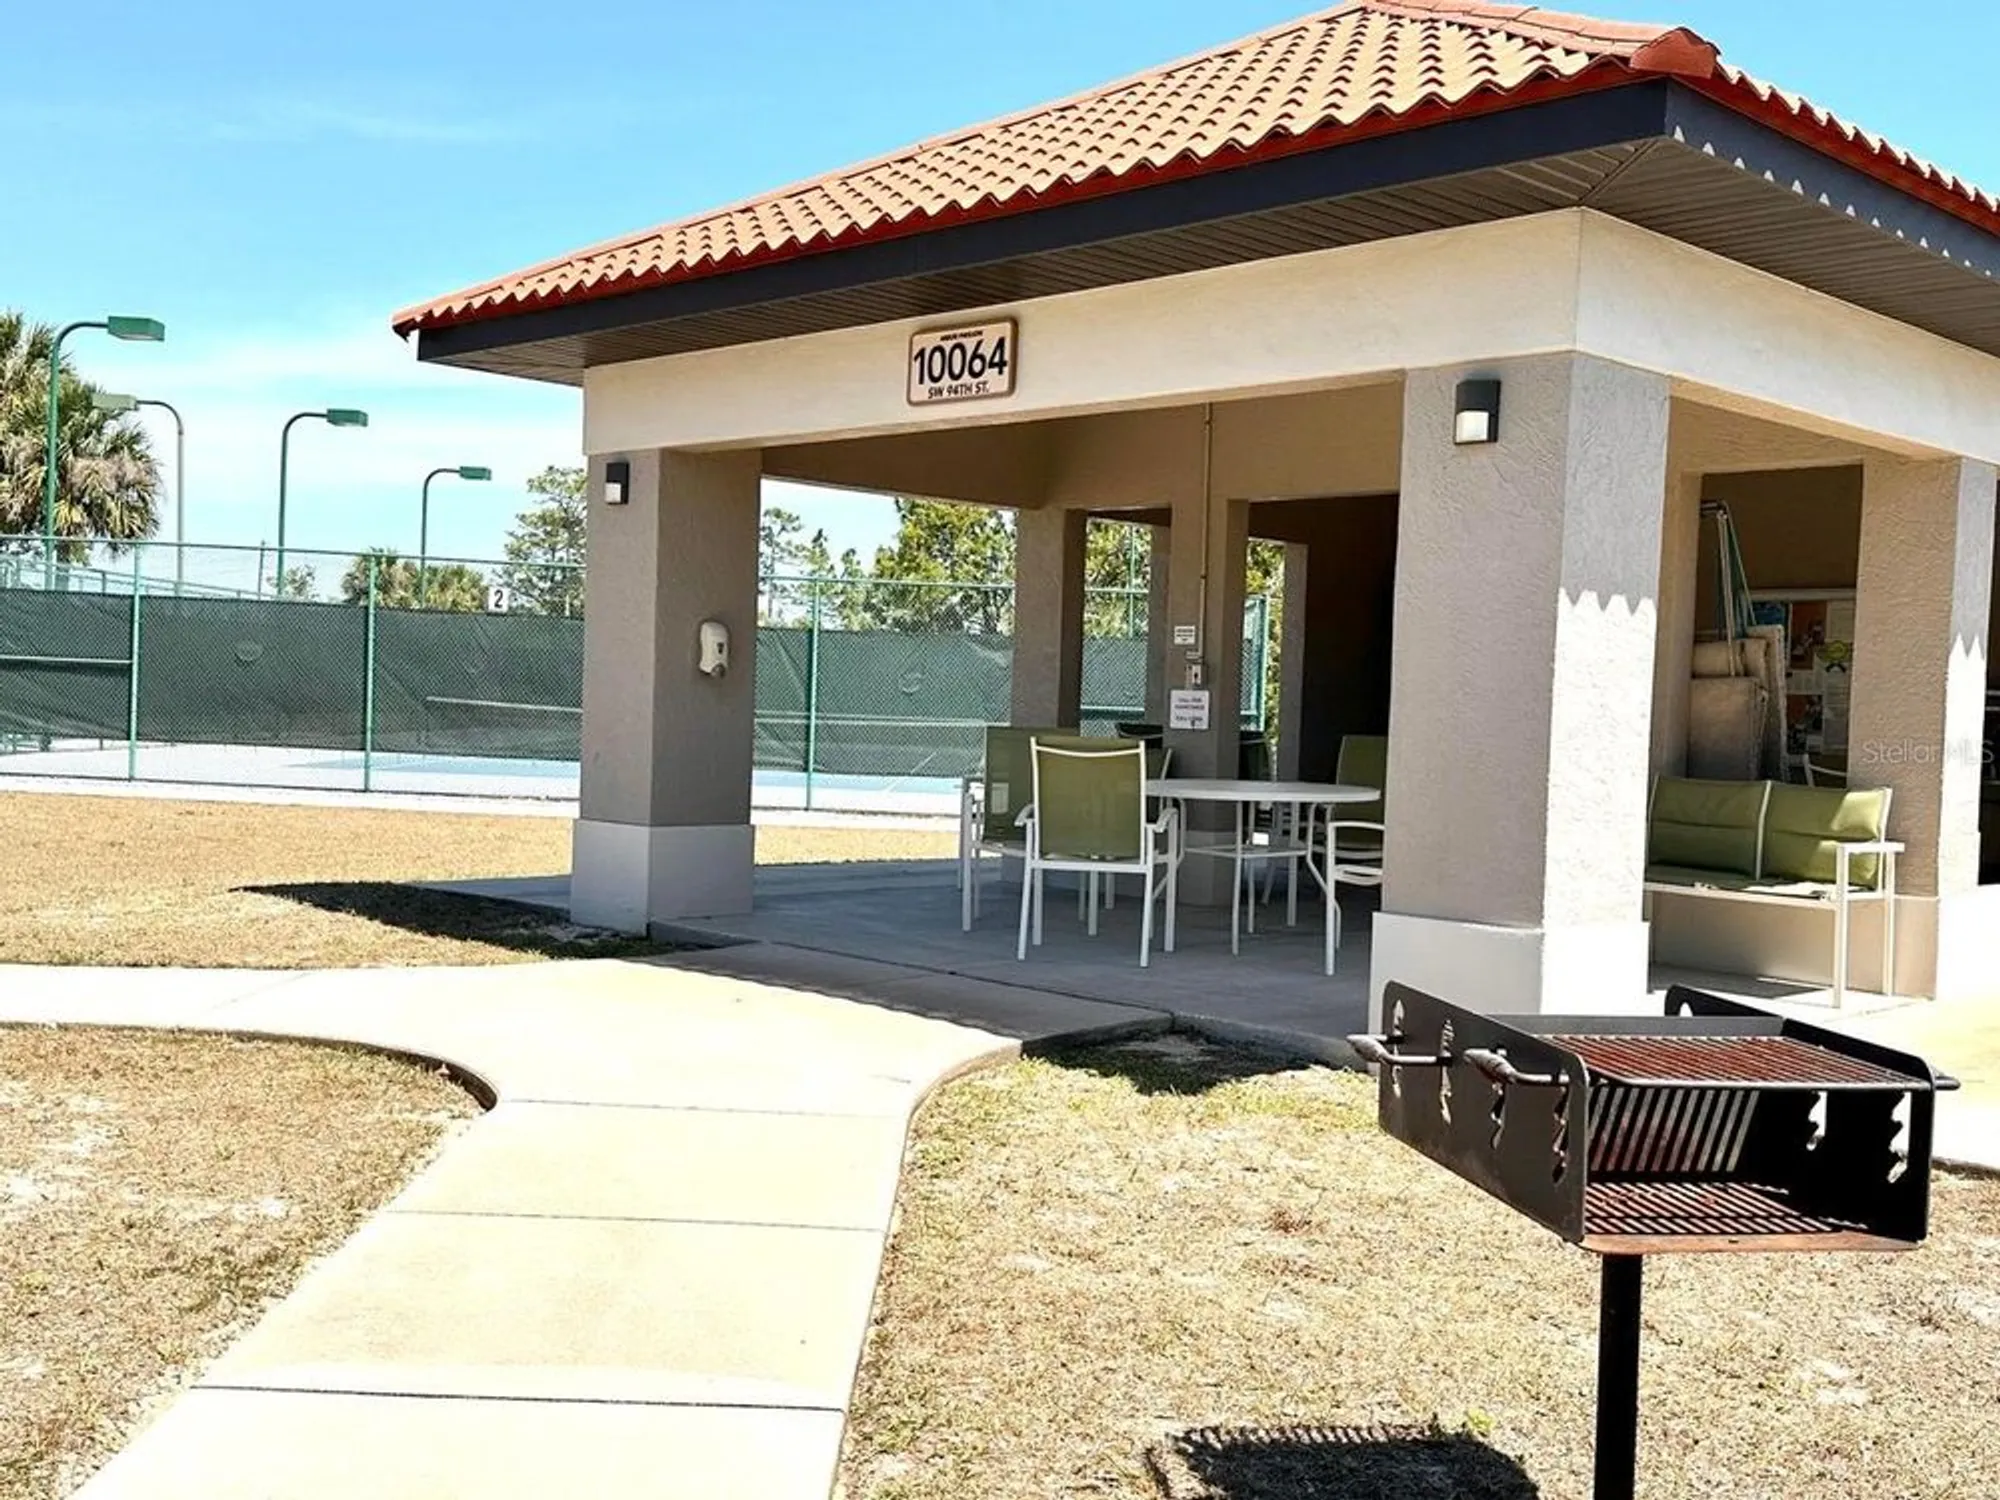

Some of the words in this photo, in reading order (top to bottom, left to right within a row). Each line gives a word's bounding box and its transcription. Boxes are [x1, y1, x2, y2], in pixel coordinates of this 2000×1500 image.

[913, 335, 1008, 385] 10064
[927, 386, 944, 400] SW
[946, 383, 973, 397] 94TH
[494, 589, 504, 608] 2
